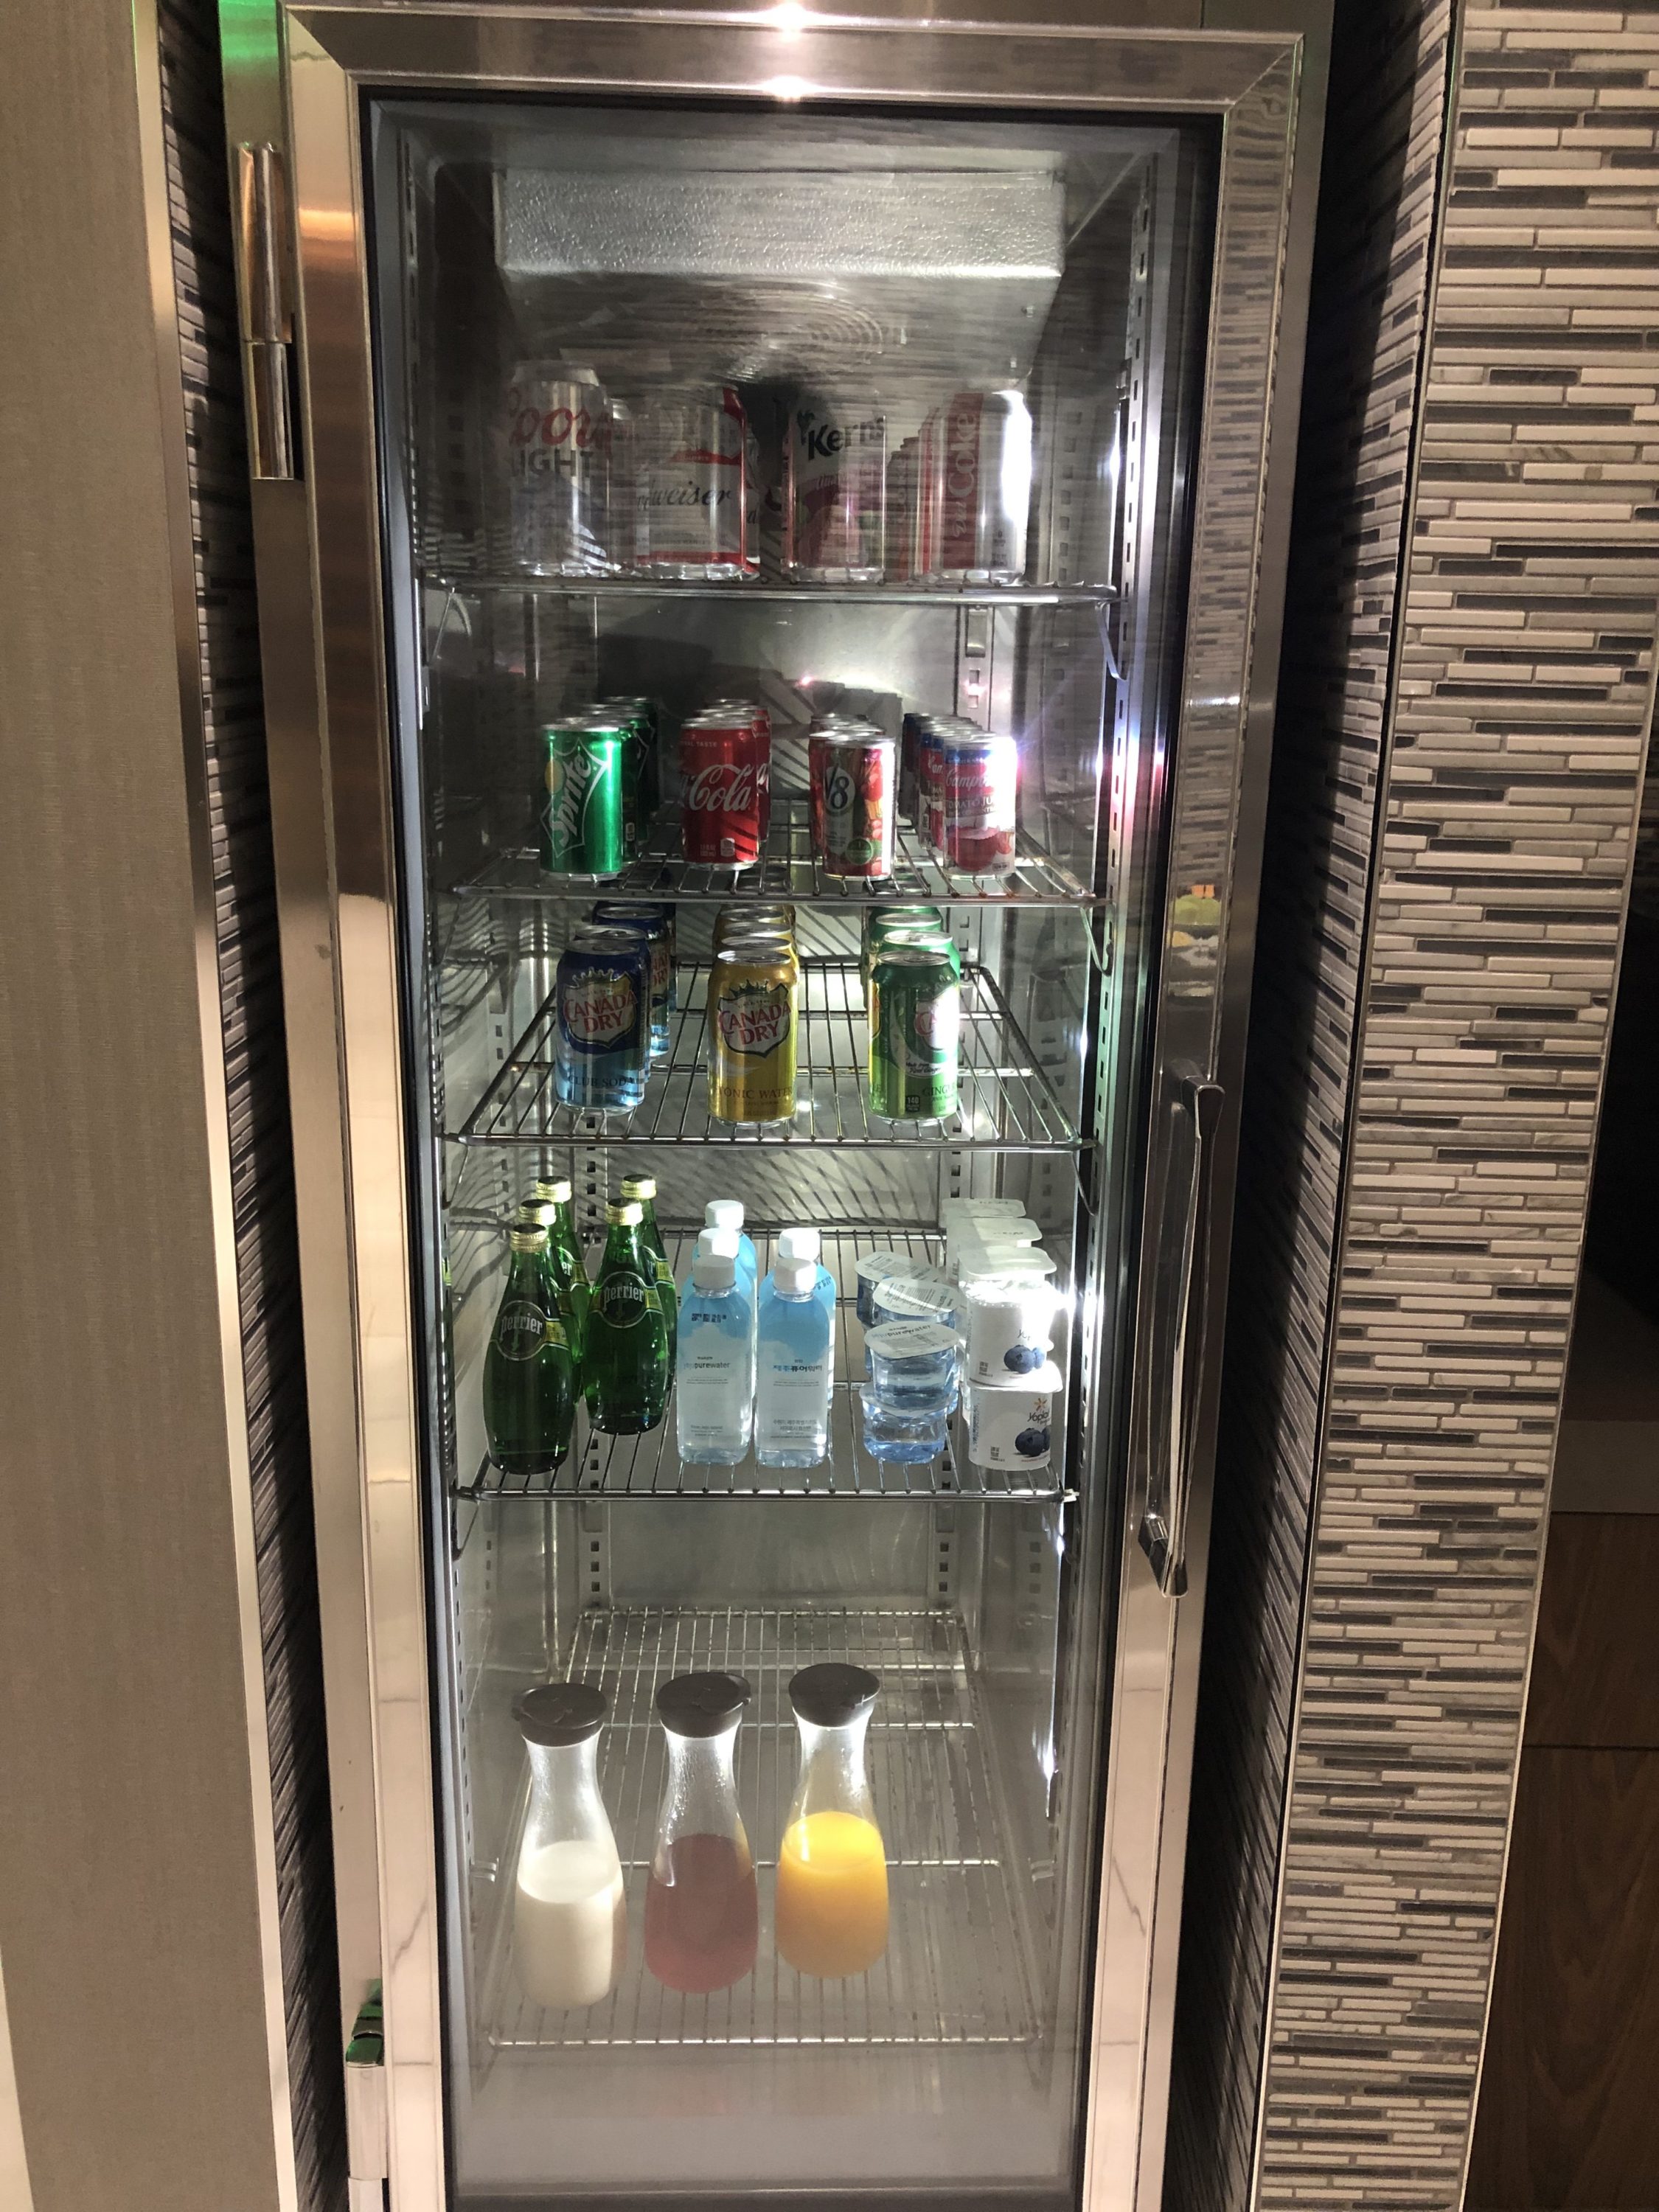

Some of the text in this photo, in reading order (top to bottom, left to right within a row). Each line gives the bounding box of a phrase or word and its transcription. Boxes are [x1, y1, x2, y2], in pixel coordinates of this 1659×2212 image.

[947, 413, 977, 498] Coke
[549, 754, 591, 848] Sprite
[563, 990, 639, 1023] CANADA
[718, 1001, 792, 1035] CANADA
[583, 1011, 623, 1034] DRY
[738, 1021, 779, 1046] DRY
[568, 1075, 635, 1087] CLUB SODA
[718, 1087, 793, 1099] TONIC WATER
[602, 1281, 644, 1312] perrier
[499, 1312, 543, 1343] perrier
